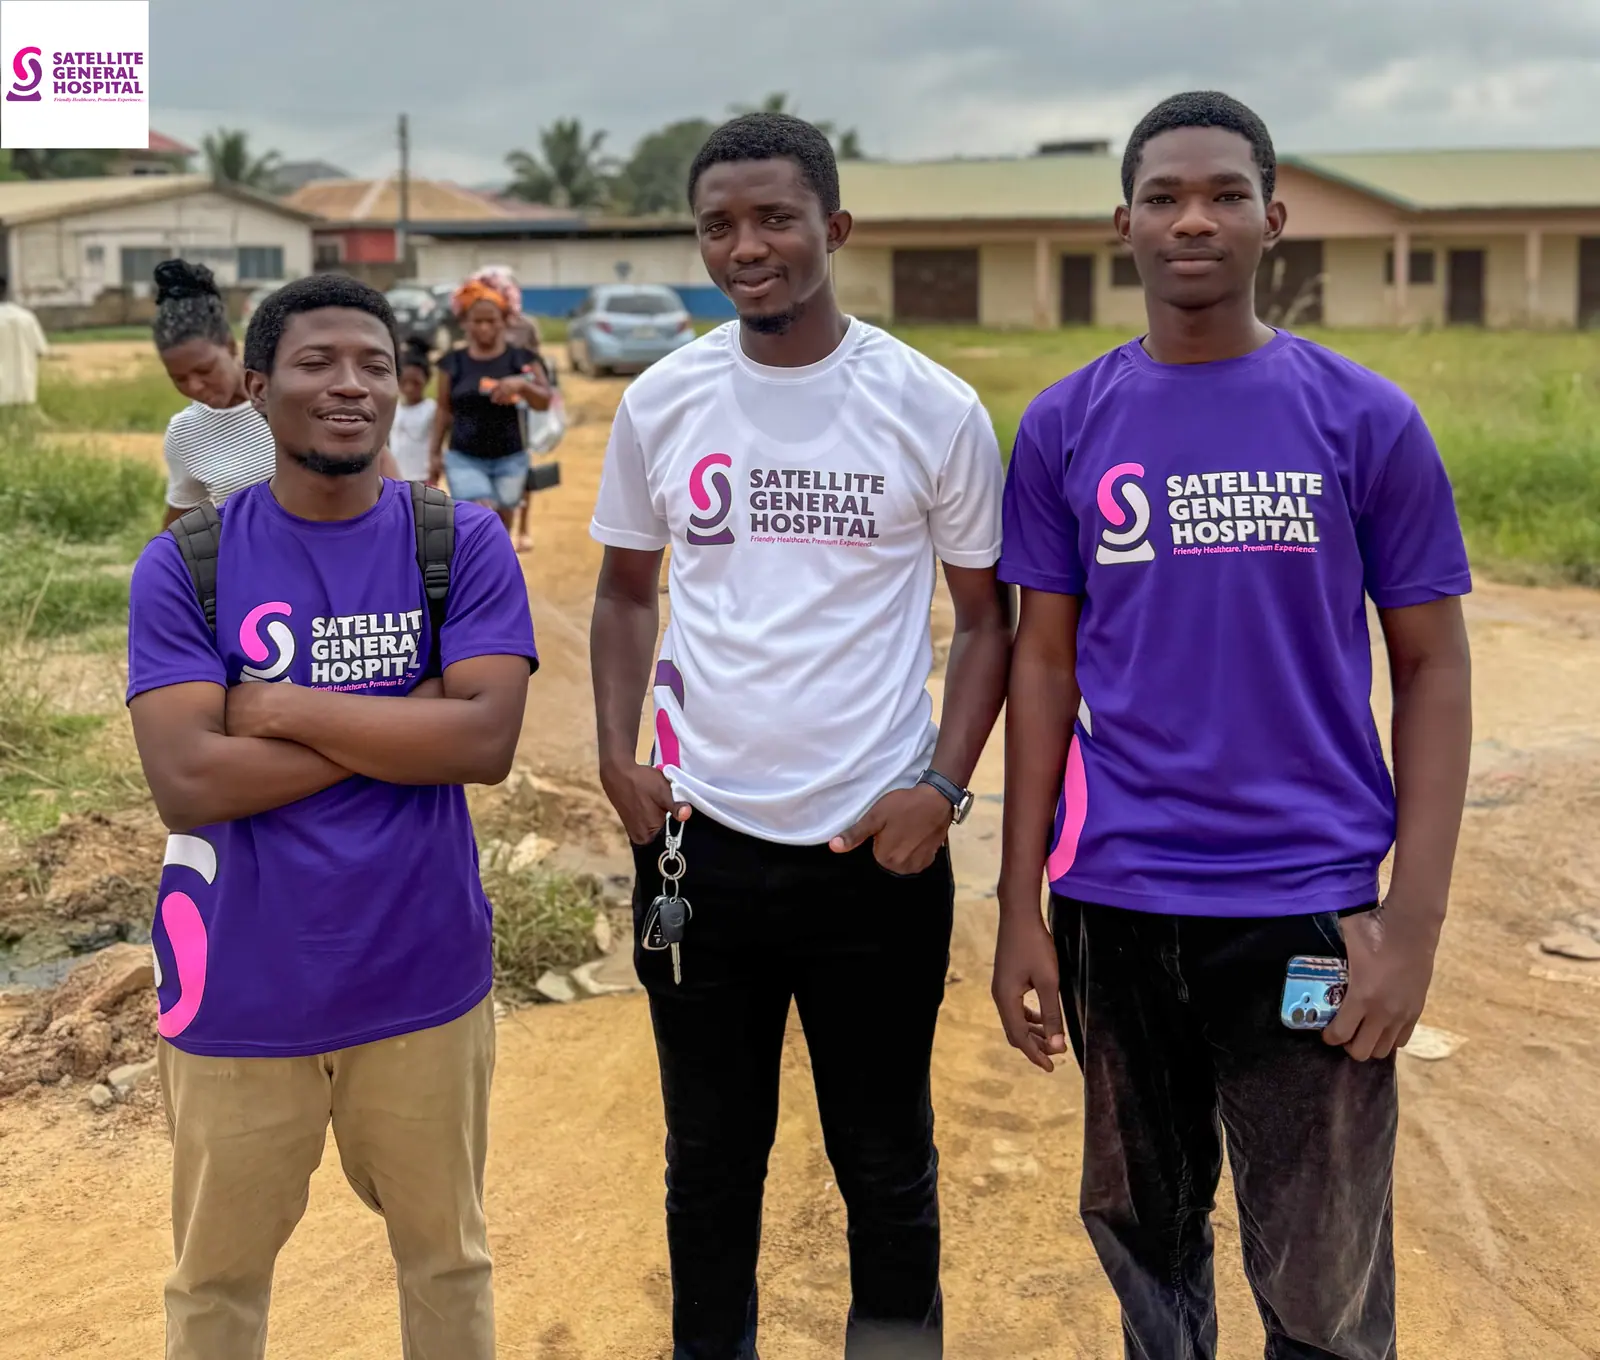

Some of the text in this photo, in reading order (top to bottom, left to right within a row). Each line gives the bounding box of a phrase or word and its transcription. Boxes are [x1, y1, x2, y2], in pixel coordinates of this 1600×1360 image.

[750, 469, 885, 495] SATELLITE
[1166, 471, 1323, 498] SATELLITE
[749, 491, 875, 516] GENERAL
[1168, 495, 1313, 521] GENERAL
[749, 513, 880, 539] HOSPITAL
[1170, 519, 1321, 545] HOSPITAL
[750, 535, 776, 544] Friendly
[812, 538, 838, 546] Premium
[1173, 546, 1202, 556] Friendly
[1243, 544, 1273, 552] Premium
[311, 609, 423, 638] SATELLIT
[311, 650, 421, 683] HOSPITL
